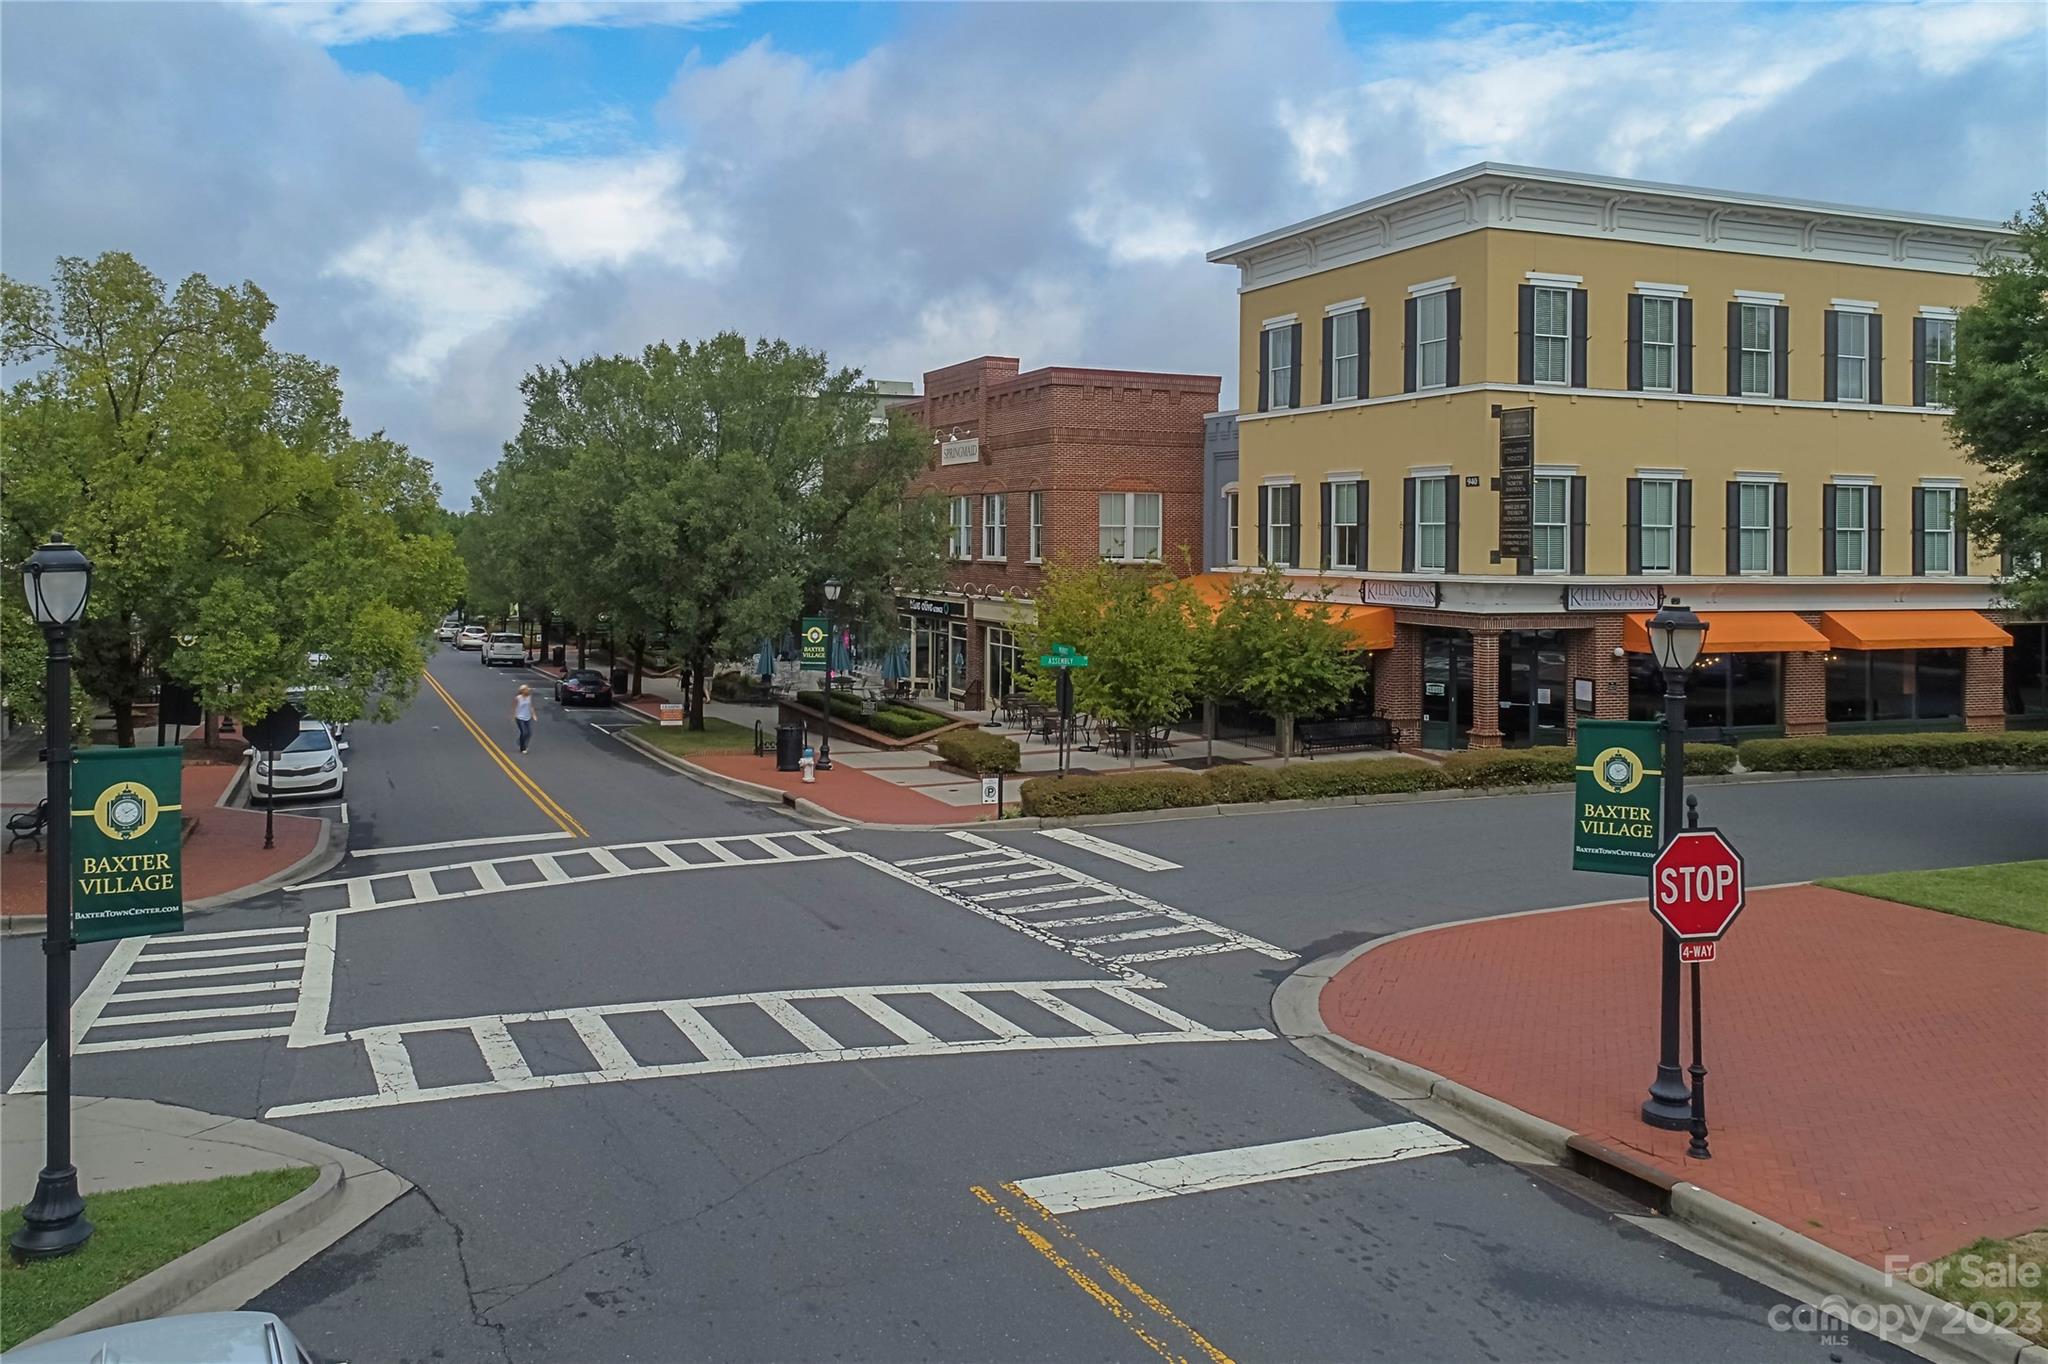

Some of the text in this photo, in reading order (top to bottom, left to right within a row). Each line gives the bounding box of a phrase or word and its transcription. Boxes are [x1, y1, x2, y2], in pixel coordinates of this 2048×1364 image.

[943, 444, 978, 459] SPRINGMAID
[1367, 583, 1436, 604] KILLINGTONS
[1570, 587, 1656, 606] KILLINGTONS
[1048, 657, 1074, 665] ASSEMBLY
[1584, 803, 1651, 821] BAXTER
[1580, 820, 1653, 838] VILLAGE
[83, 853, 171, 874] BAXTER
[79, 874, 174, 895] VILLAGE
[1660, 864, 1734, 904] STOP
[1682, 945, 1713, 958] 4-WAY
